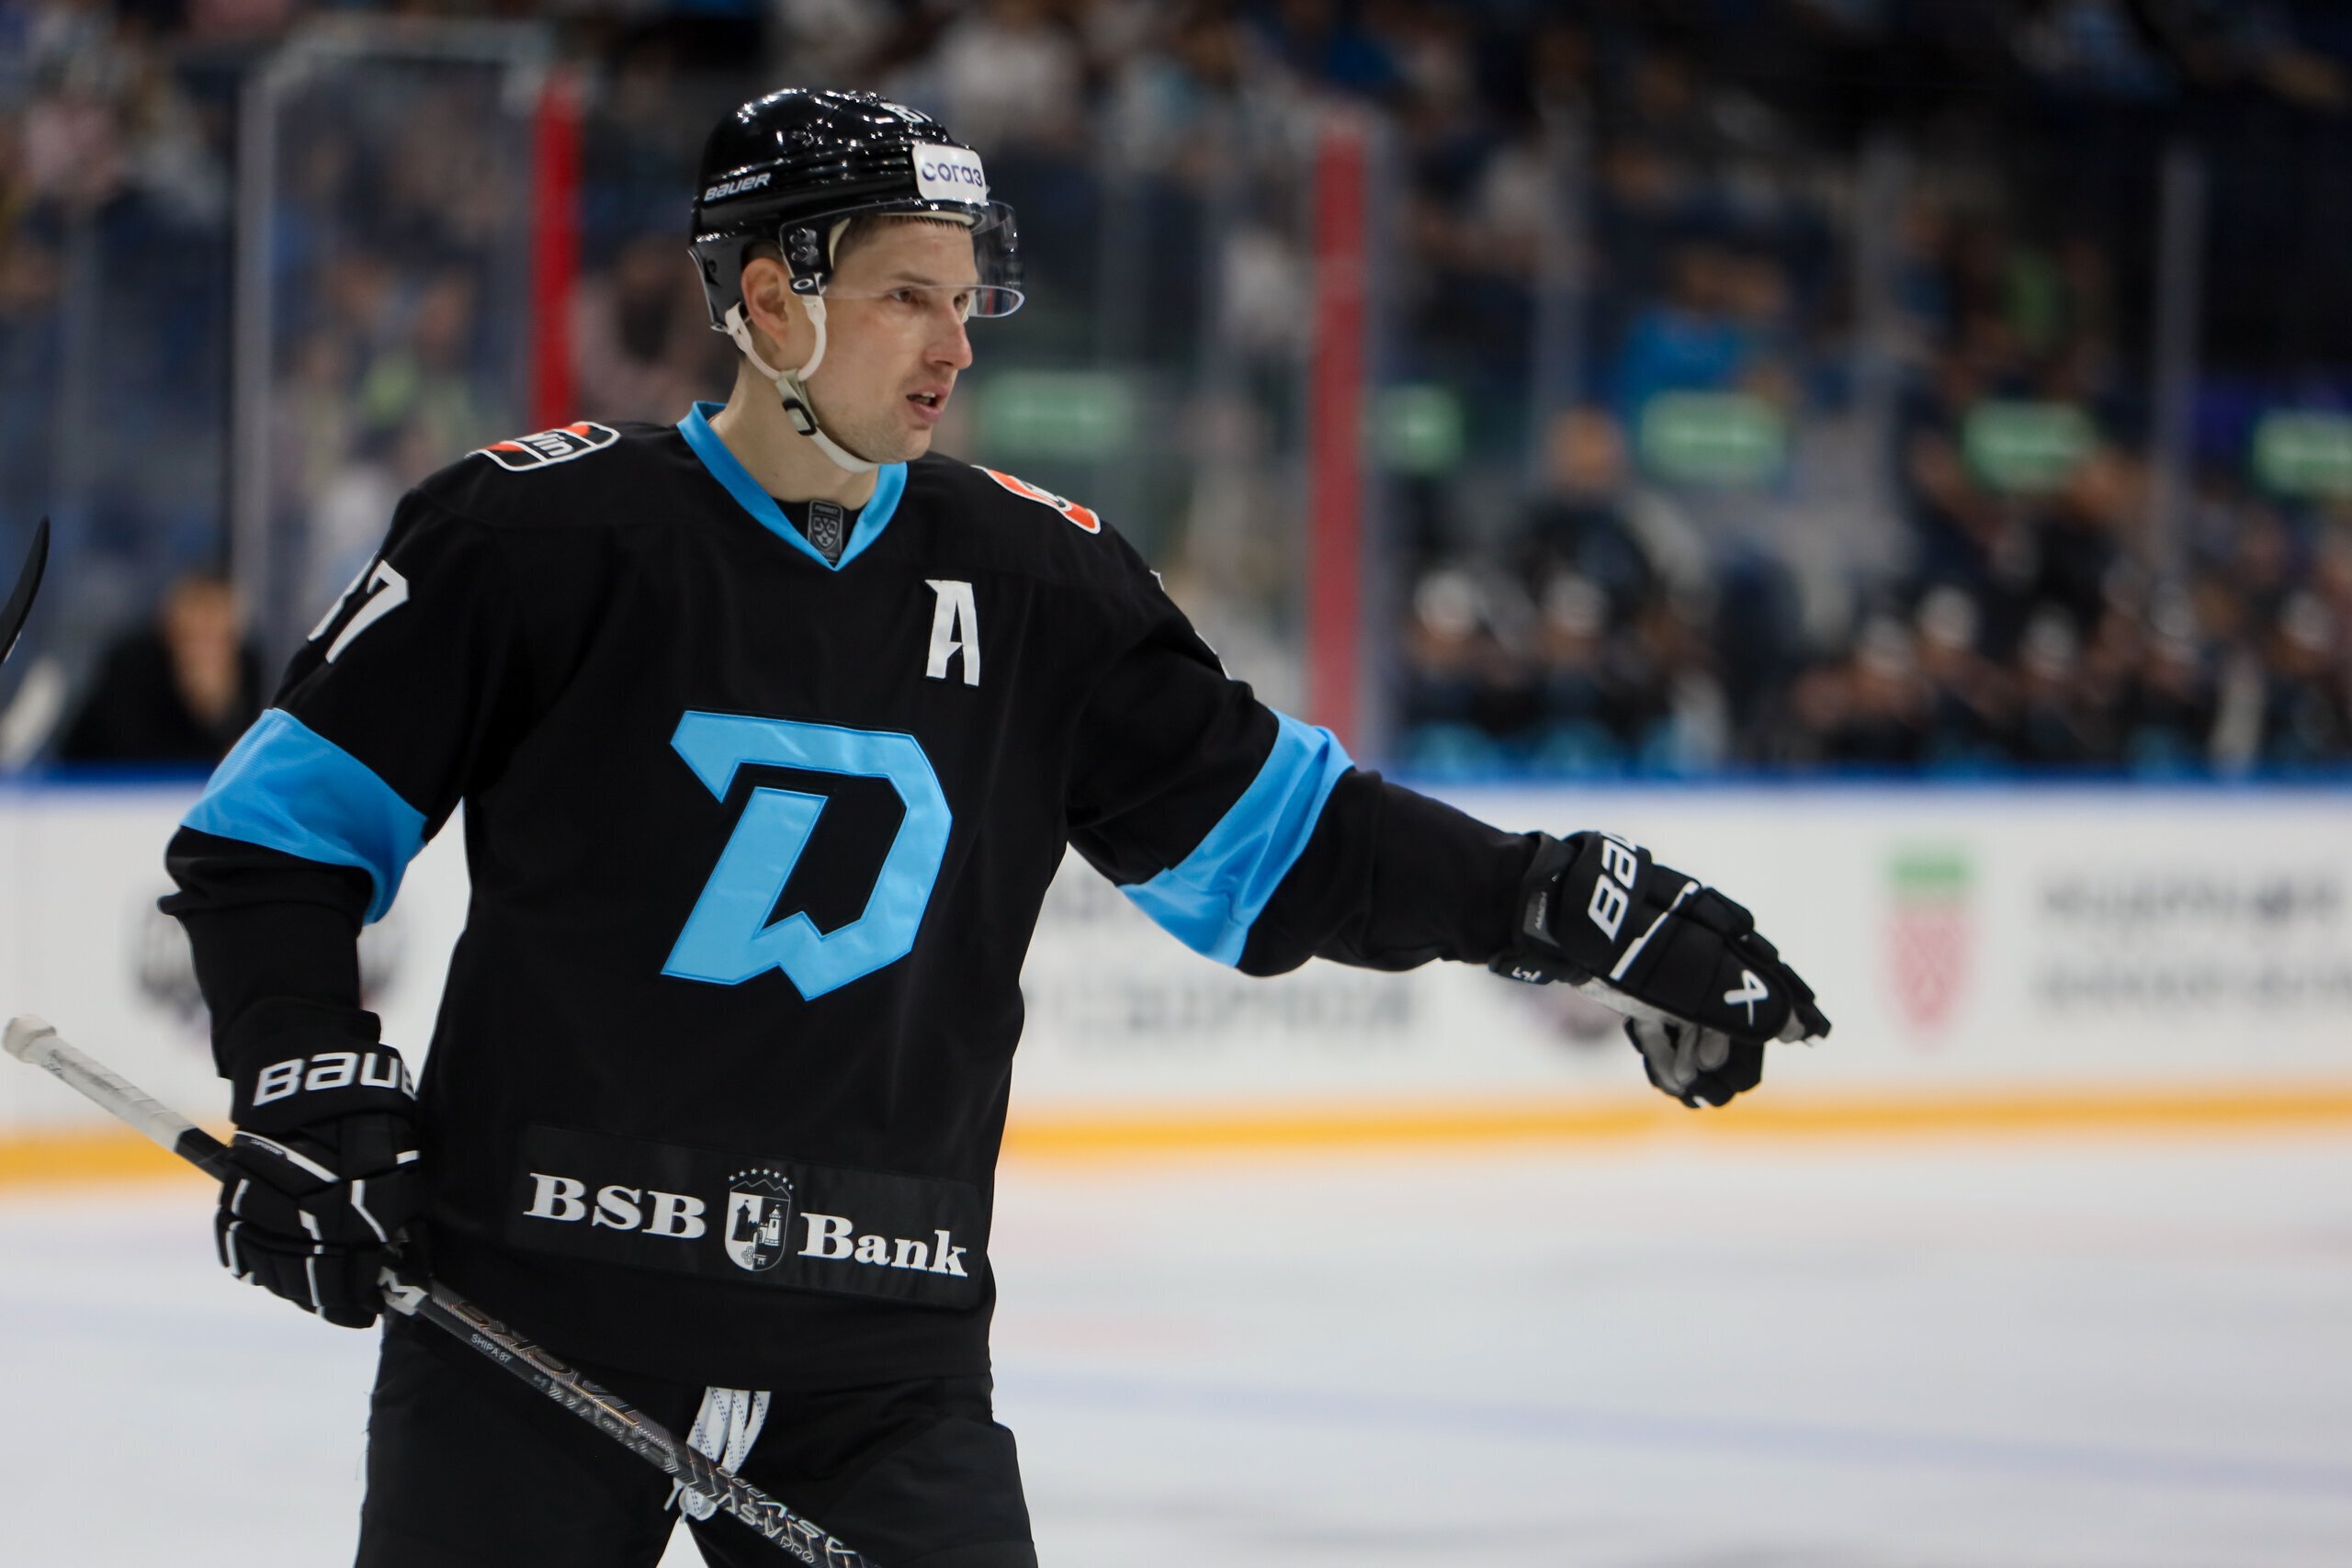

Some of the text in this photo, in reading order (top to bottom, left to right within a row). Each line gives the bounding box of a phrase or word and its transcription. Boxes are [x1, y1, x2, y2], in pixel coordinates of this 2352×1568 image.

[307, 549, 410, 664] 7
[925, 581, 979, 687] A
[660, 710, 953, 1002] D
[523, 1173, 968, 1278] BSB Bank
